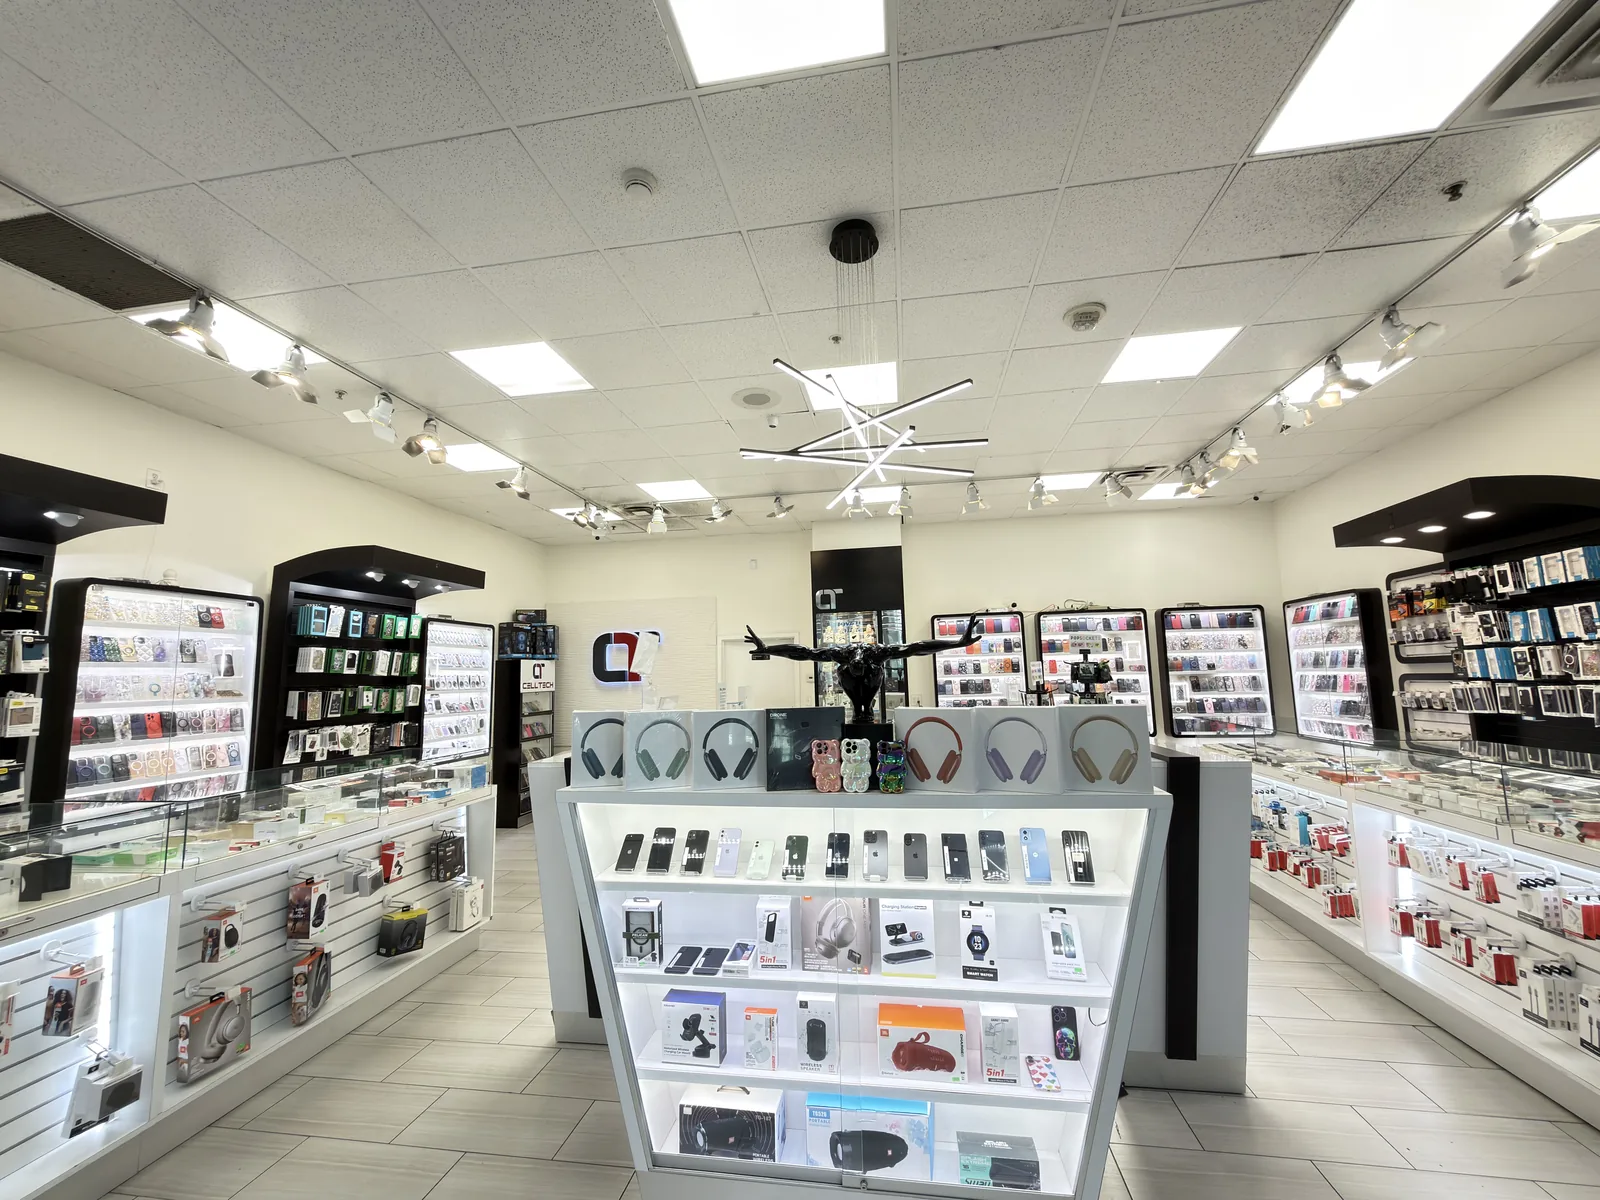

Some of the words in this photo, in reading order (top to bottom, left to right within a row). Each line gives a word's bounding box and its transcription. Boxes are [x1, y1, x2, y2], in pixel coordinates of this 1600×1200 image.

[522, 682, 554, 690] CELLTECH
[973, 935, 982, 943] 10
[973, 943, 982, 951] 23
[760, 956, 777, 964] 5in1
[986, 1068, 1005, 1077] 5in1
